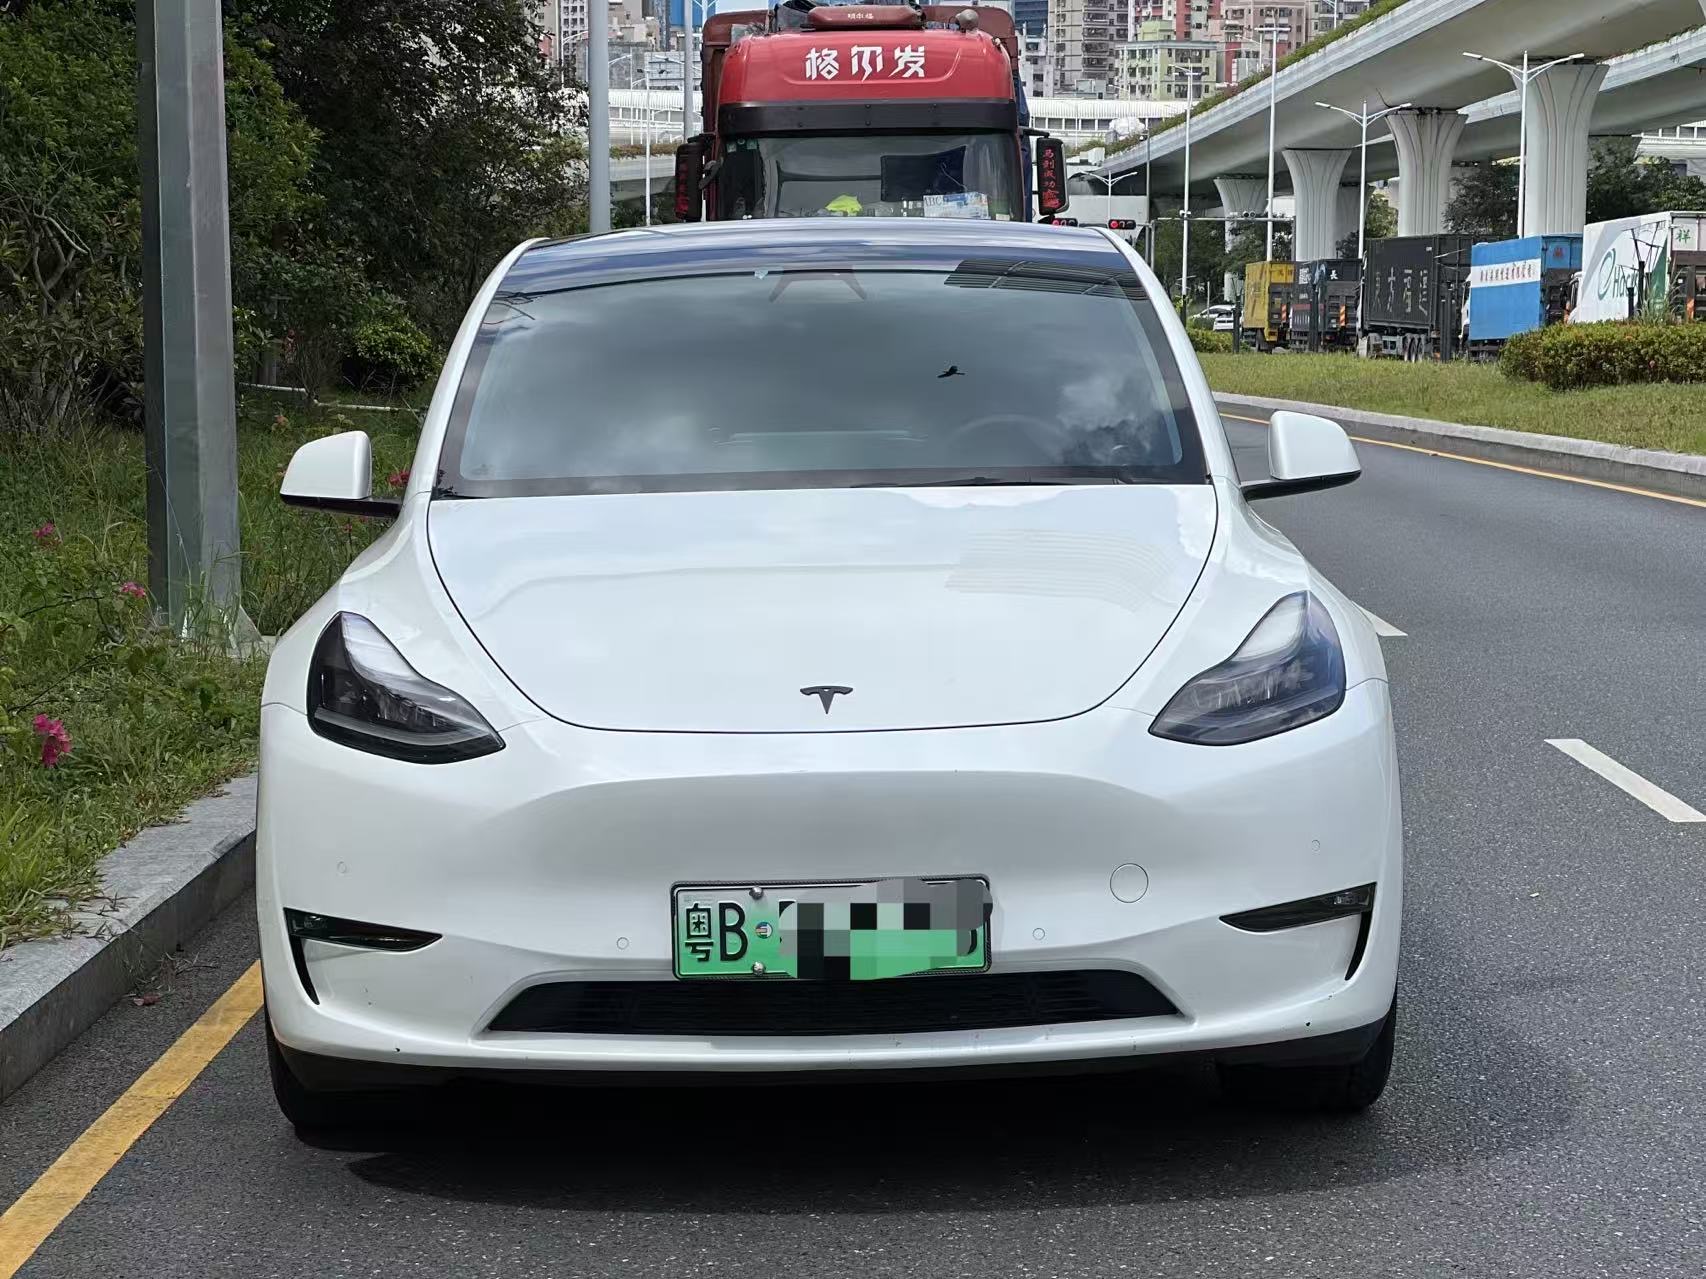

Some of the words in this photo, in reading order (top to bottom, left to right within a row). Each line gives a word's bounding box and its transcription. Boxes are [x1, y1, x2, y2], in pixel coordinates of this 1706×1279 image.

[804, 44, 926, 82] 格尔发
[1675, 228, 1691, 244] 祥
